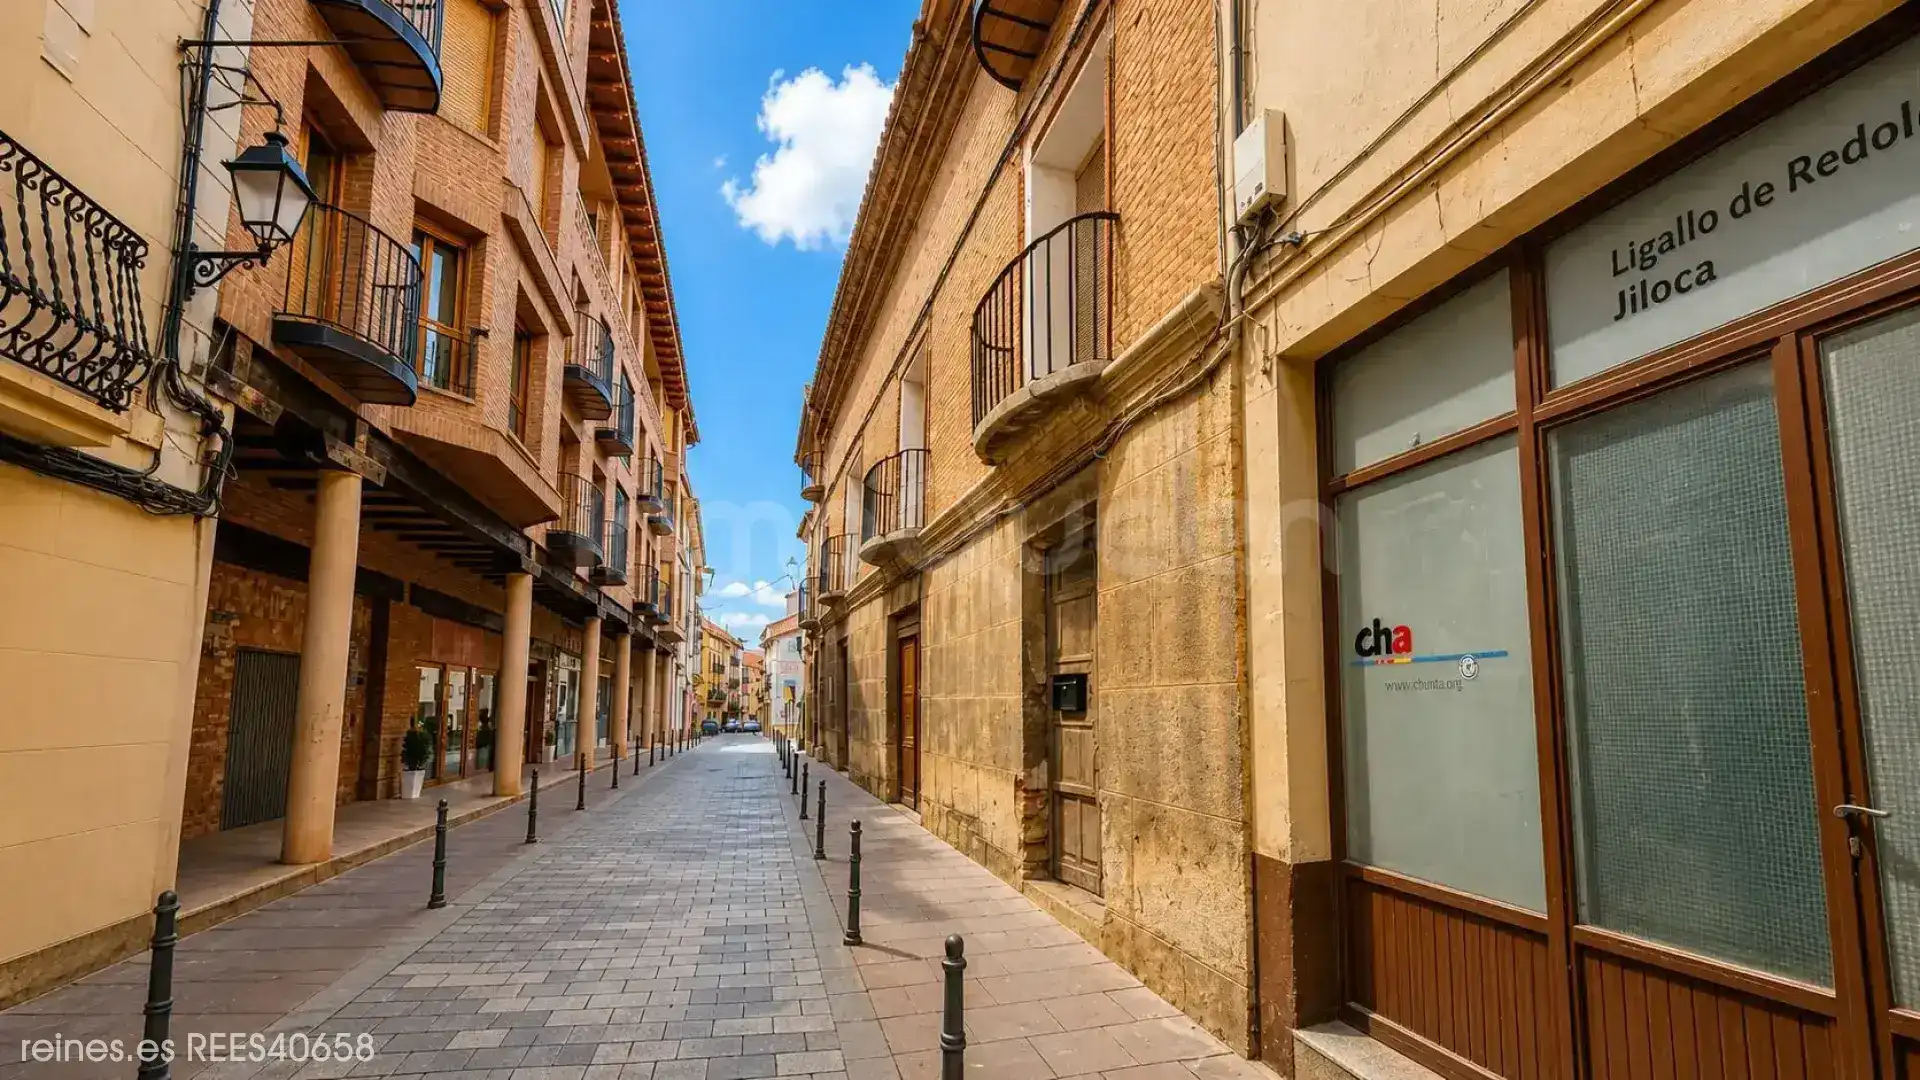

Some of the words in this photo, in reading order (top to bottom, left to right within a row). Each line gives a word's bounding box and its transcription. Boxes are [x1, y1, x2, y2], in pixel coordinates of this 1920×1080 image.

[1611, 208, 1720, 278] Ligallo
[1729, 181, 1776, 221] de
[1788, 100, 1920, 193] Redol
[1614, 260, 1718, 322] Jiloca
[1355, 618, 1413, 658] cha
